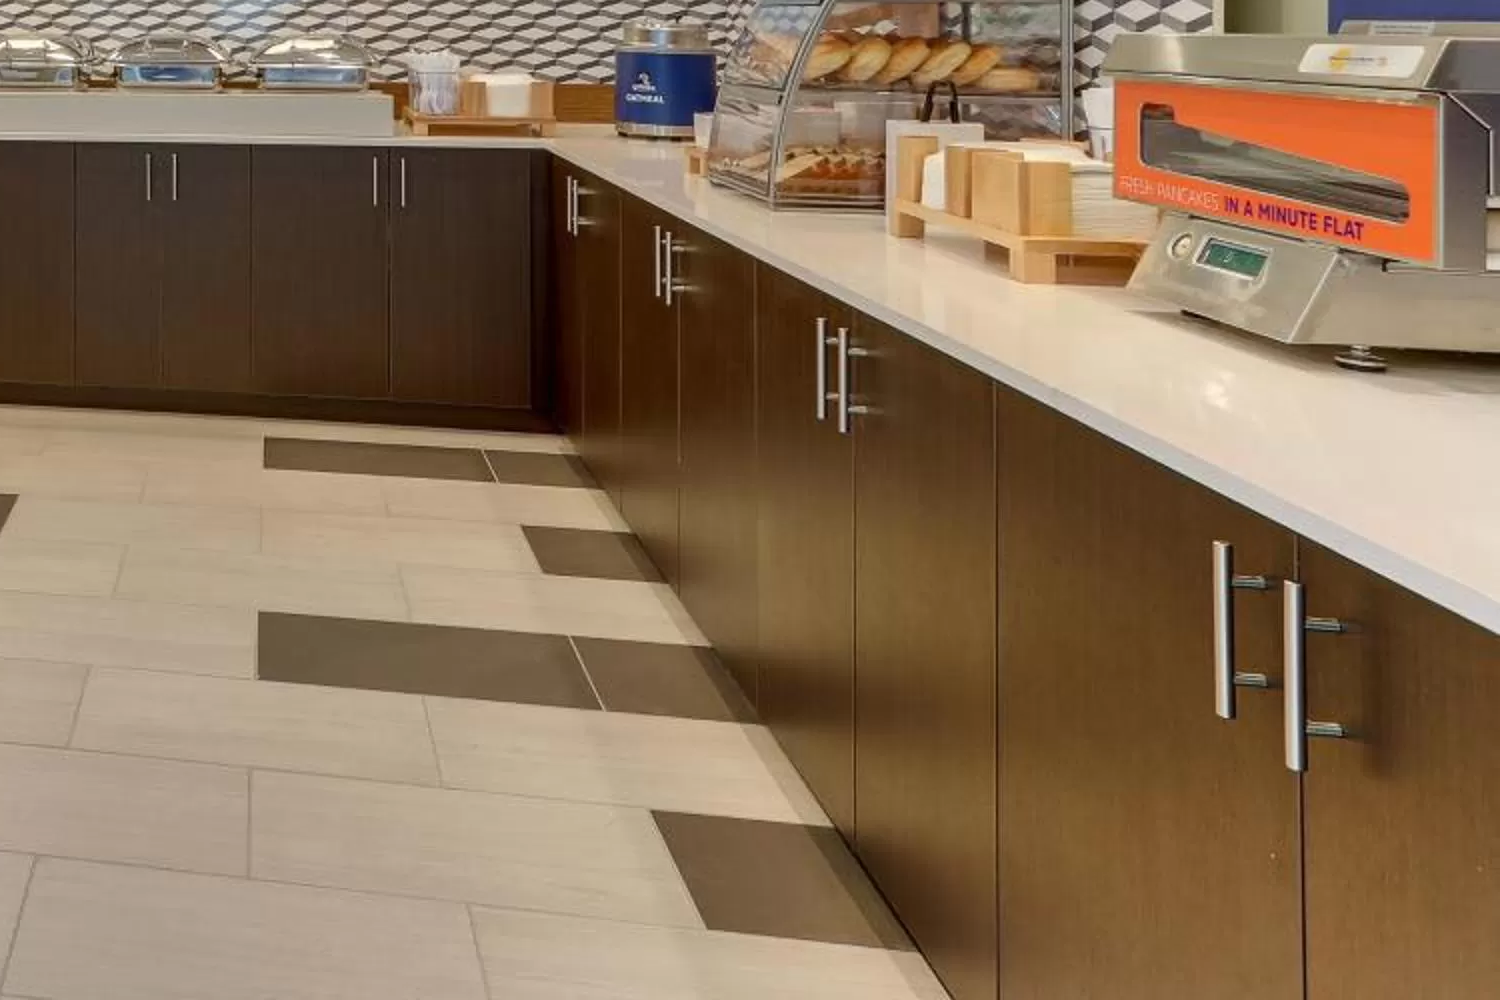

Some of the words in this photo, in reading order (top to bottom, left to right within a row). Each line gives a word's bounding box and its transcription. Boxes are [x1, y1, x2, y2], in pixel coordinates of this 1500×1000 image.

[1157, 182, 1220, 212] PANCAKES
[1224, 196, 1238, 213] IN
[1243, 200, 1254, 217] A
[1258, 203, 1318, 231] MINUTE
[1323, 216, 1365, 241] FLAT
